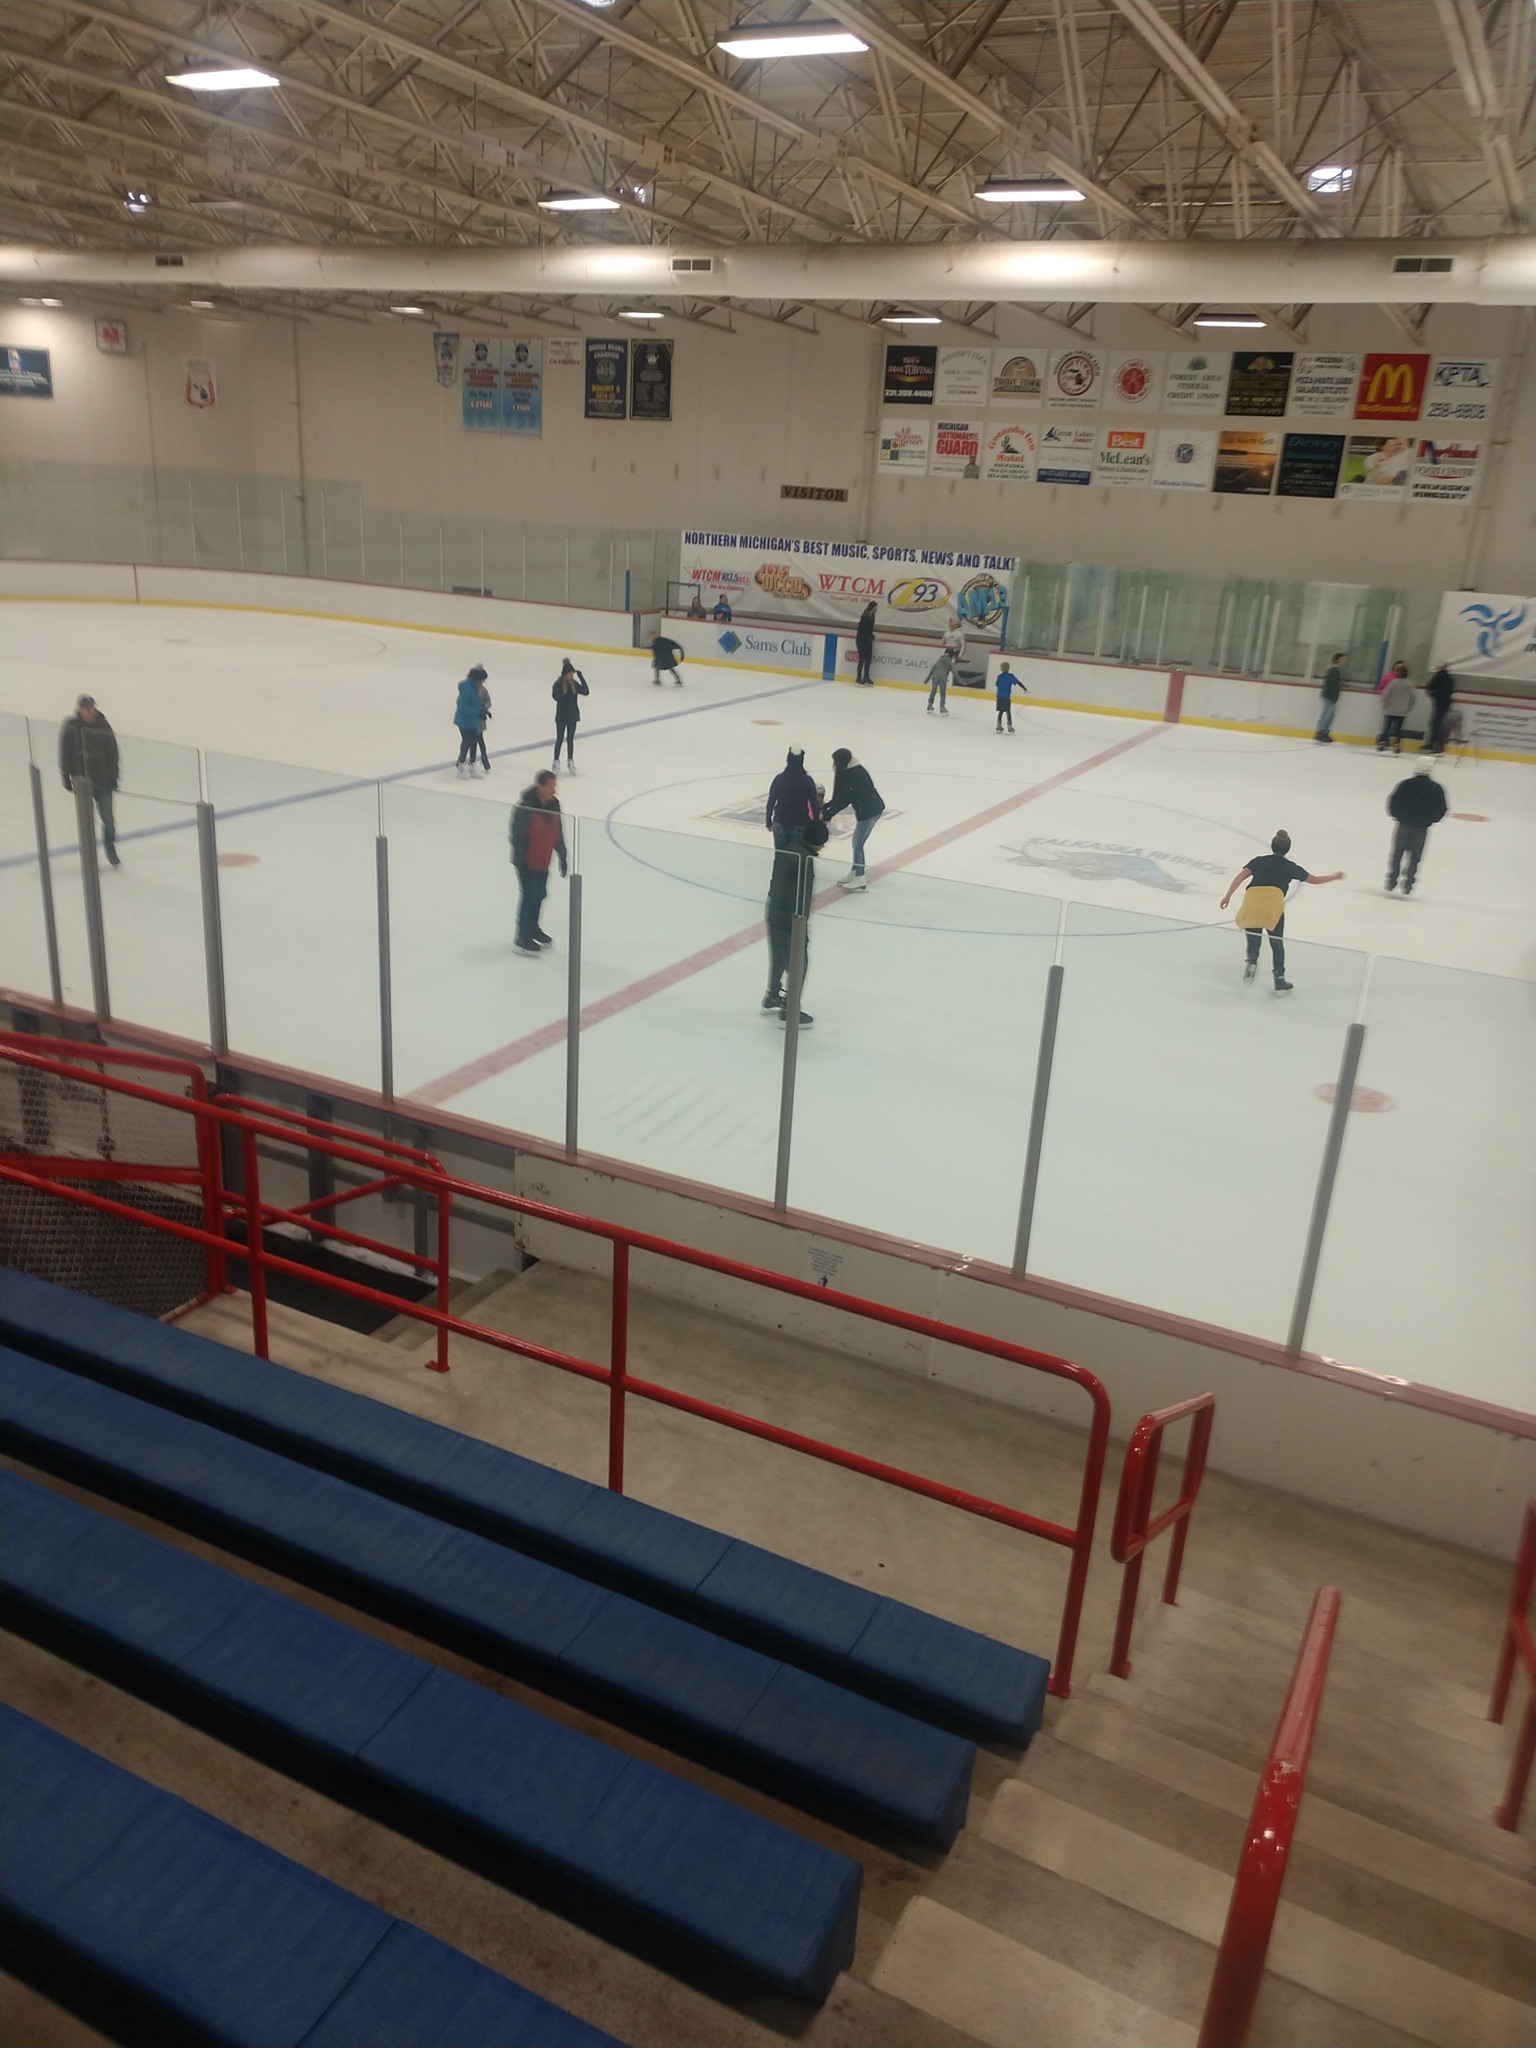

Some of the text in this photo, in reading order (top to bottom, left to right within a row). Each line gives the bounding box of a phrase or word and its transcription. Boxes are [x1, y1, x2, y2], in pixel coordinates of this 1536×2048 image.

[994, 378, 1040, 387] TROUT TOWN
[1358, 404, 1417, 413] McDonald's
[937, 422, 969, 431] MICHIGAN
[937, 431, 970, 439] NATIONAL
[936, 439, 979, 455] GUARD
[996, 453, 1024, 463] Motel
[1100, 451, 1150, 466] McLean's
[783, 486, 845, 501] VISITOR
[684, 531, 1015, 571] NORTHERN MICHIGAN'S BEST MUSIC, SPORTS, NEWS AND TALK!
[692, 569, 721, 582] WTCM
[818, 573, 886, 595] WTCM
[745, 634, 811, 657] Sam's Club
[871, 655, 903, 665] MOTOR
[905, 659, 928, 669] SALES
[1030, 837, 1230, 875] KALKASKA RHINOS
